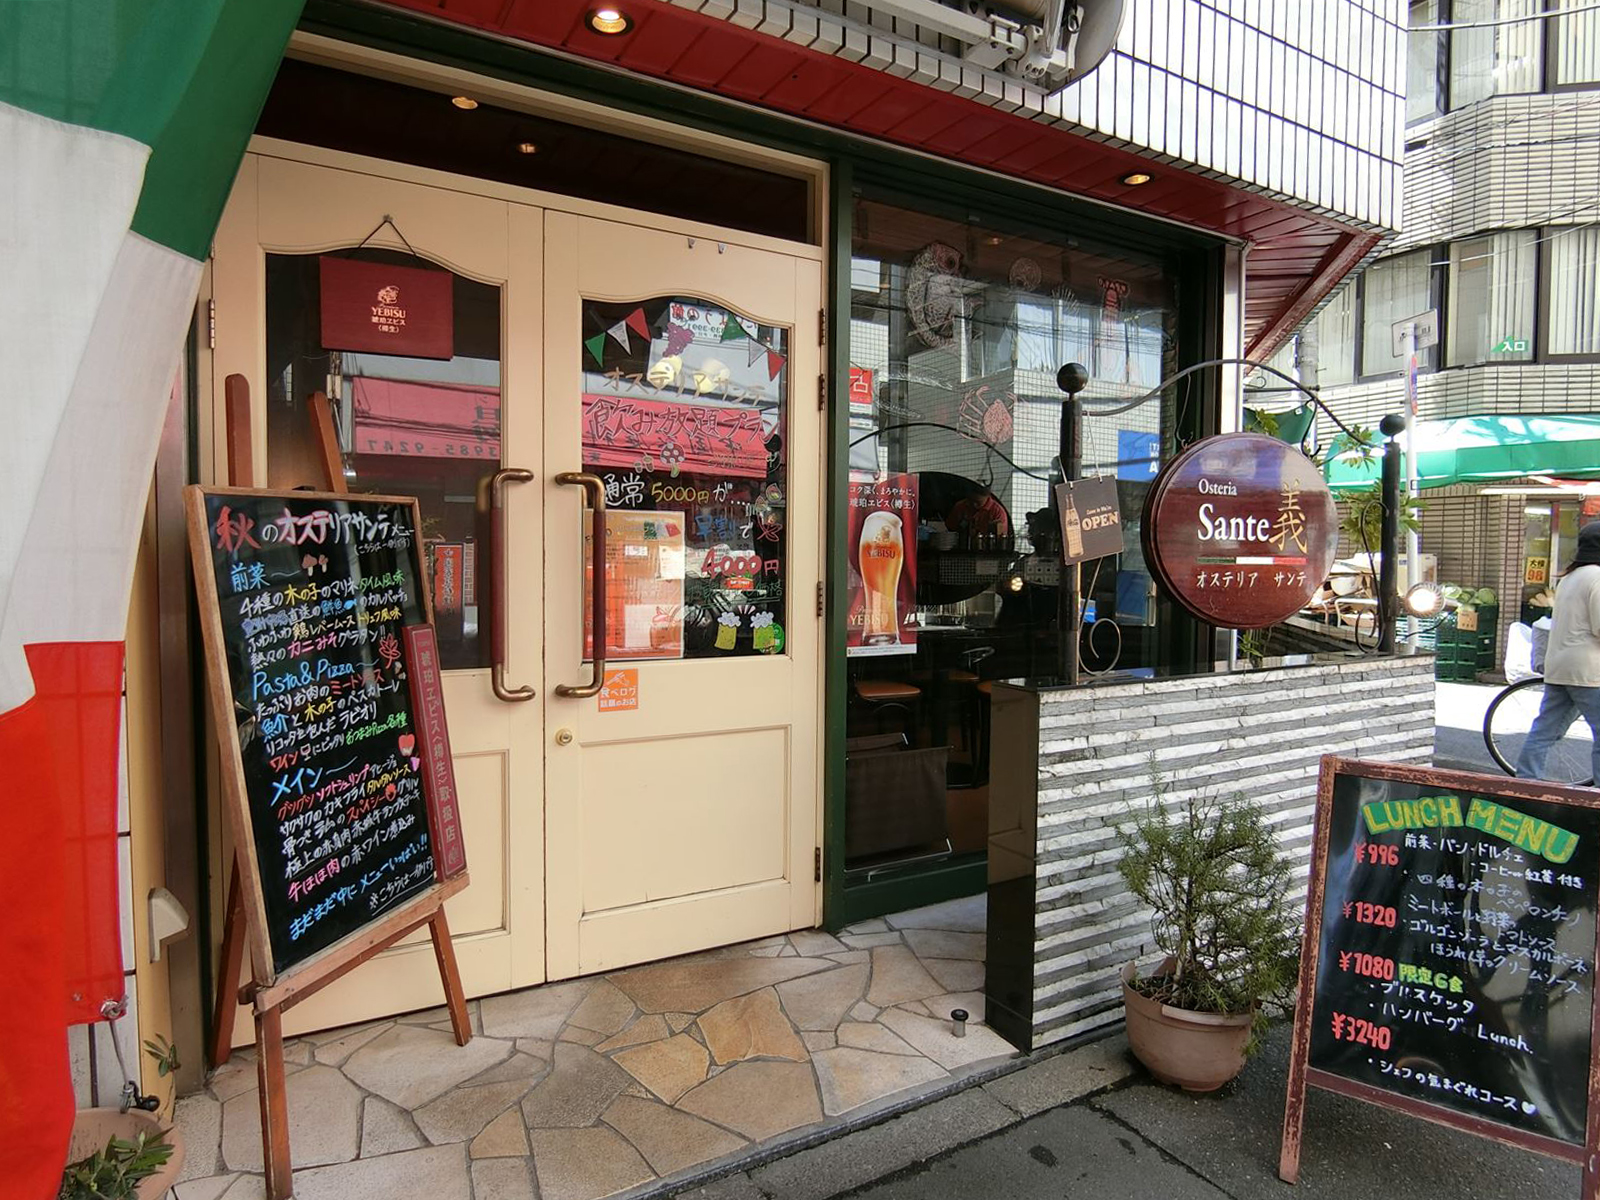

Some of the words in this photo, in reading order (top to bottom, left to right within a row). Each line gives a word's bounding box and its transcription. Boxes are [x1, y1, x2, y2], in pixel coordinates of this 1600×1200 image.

[371, 306, 406, 319] YEBISU
[1502, 341, 1525, 352] 入口
[585, 398, 779, 445] 飲み放題プラン
[603, 472, 646, 507] 通常
[651, 481, 710, 505] 5000円
[1198, 478, 1238, 496] Osteria
[1082, 511, 1119, 531] OPEN
[1198, 503, 1270, 542] Sante
[1269, 478, 1308, 554] 義
[701, 546, 780, 580] 4000円
[867, 550, 896, 560] YEBISU
[230, 562, 270, 592] 前菜
[1196, 571, 1259, 588] オステリア
[1274, 571, 1307, 588] サンテ
[1528, 570, 1543, 581] 98
[850, 614, 889, 627] YEBISU
[270, 767, 323, 807] メイン
[1363, 796, 1464, 835] LUNCH
[1466, 798, 1579, 863] MENU
